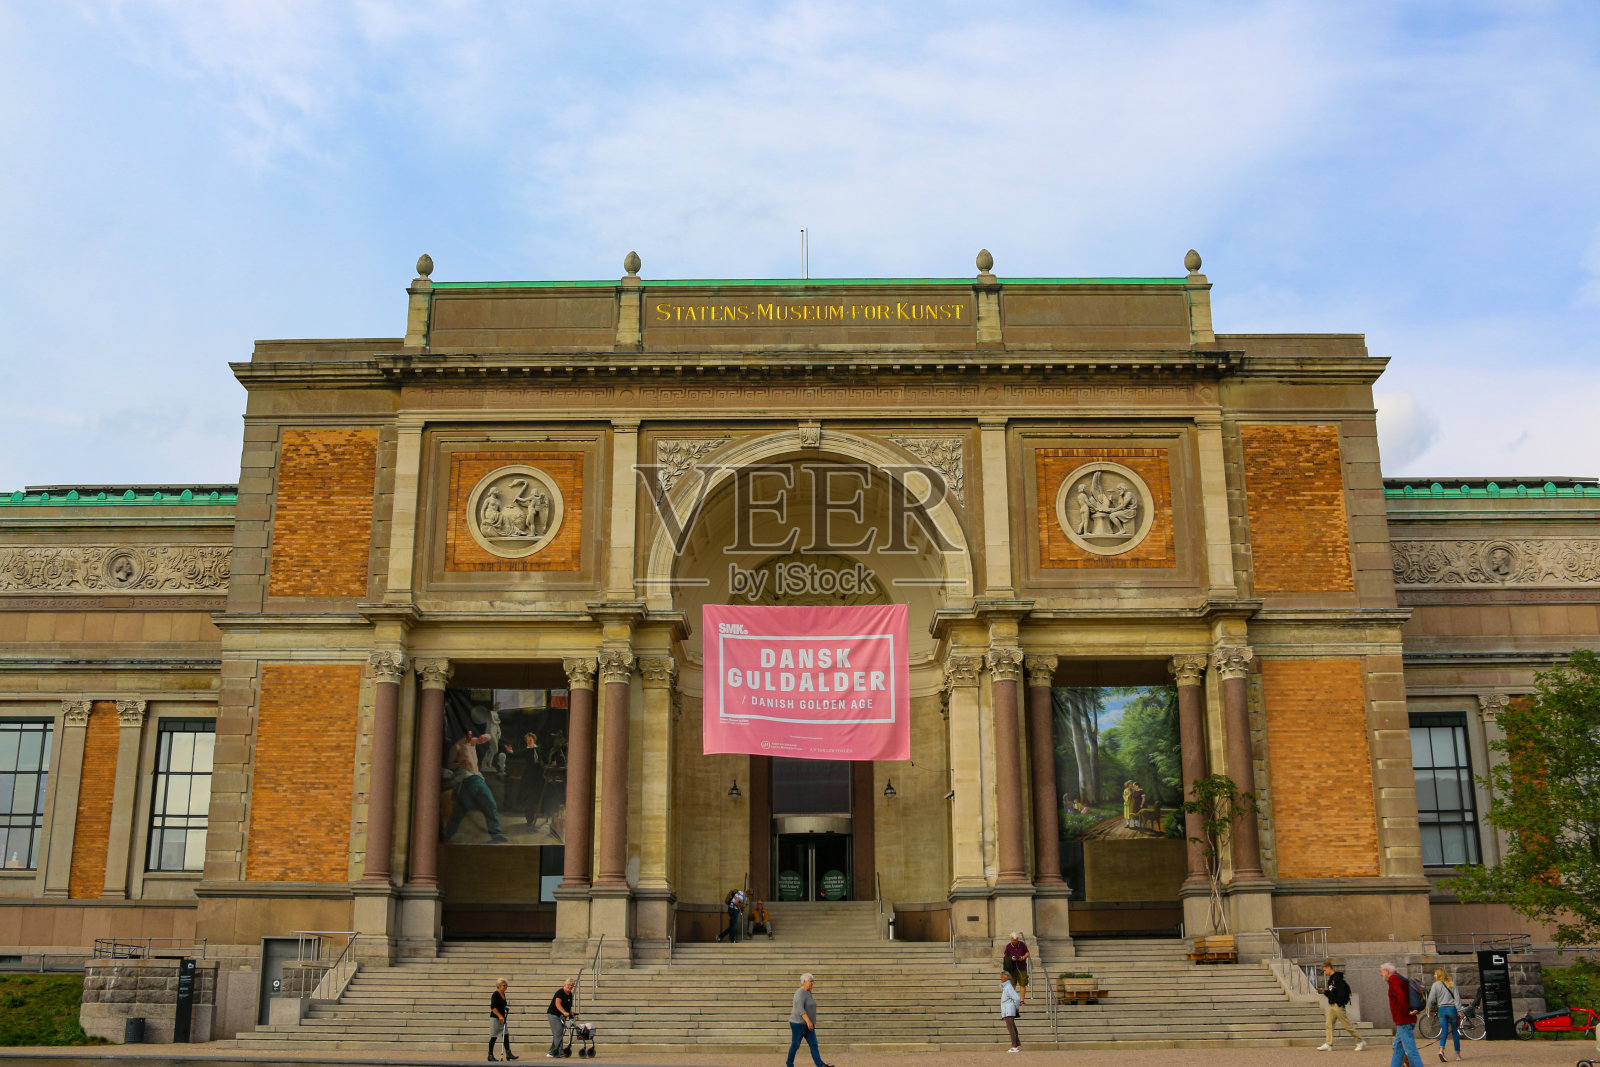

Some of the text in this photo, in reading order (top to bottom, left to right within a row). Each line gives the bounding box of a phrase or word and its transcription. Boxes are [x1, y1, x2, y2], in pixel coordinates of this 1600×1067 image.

[656, 303, 749, 321] STATENS
[757, 303, 844, 321] MUSEUM
[896, 302, 964, 320] KUNST
[760, 648, 852, 669] DANSK
[727, 667, 886, 692] GULDALDER
[751, 696, 795, 710] DANISH
[799, 698, 846, 710] GOLDEN
[850, 698, 873, 710] AGE
